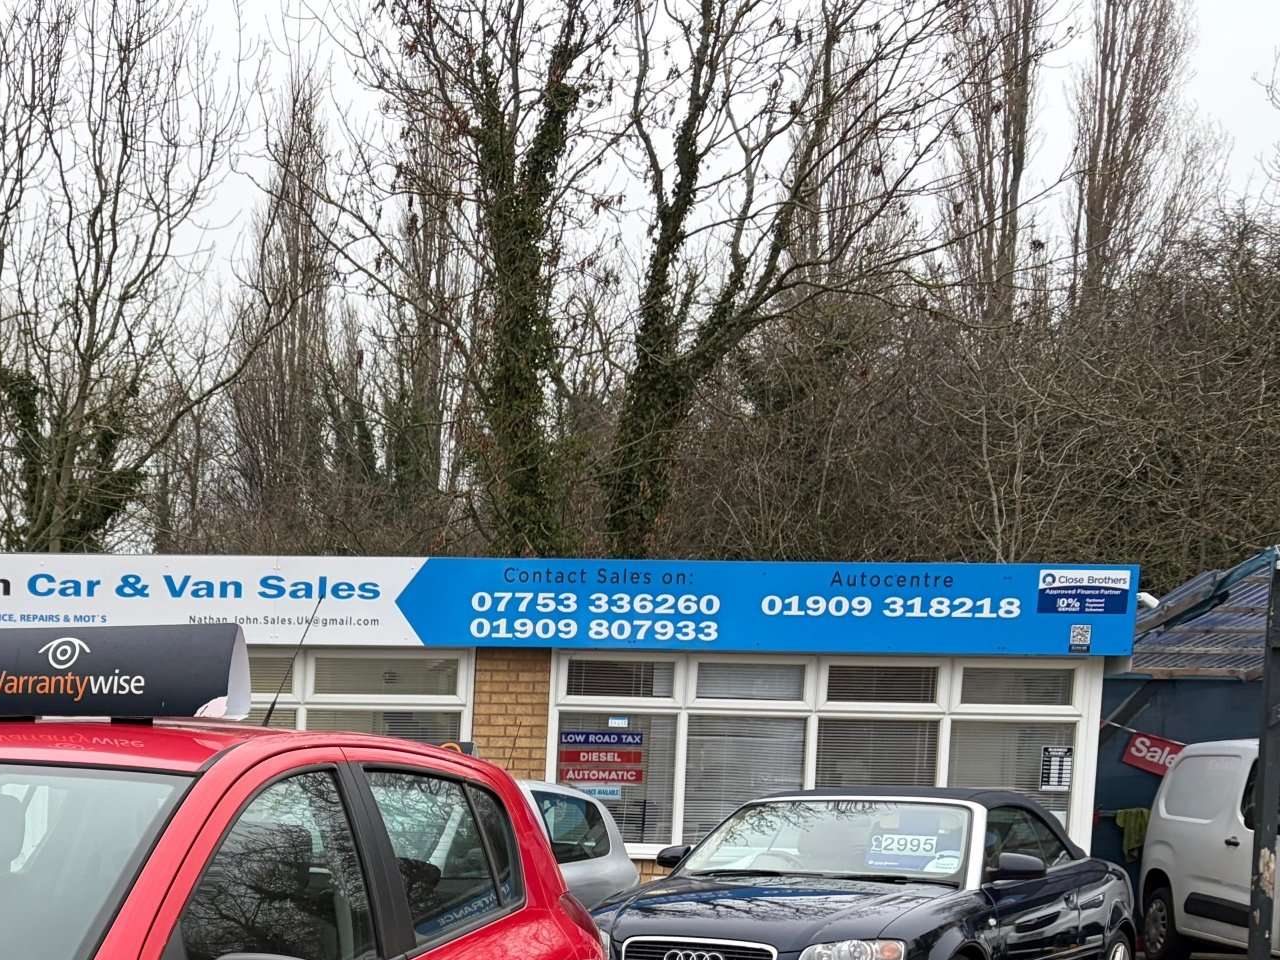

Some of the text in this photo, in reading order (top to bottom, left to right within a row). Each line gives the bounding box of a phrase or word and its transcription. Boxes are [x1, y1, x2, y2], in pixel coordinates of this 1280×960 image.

[504, 567, 694, 585] Contact Sales on:
[830, 570, 954, 588] Autocentre
[1058, 575, 1128, 586] Close Brothers
[27, 573, 101, 597] Car
[115, 574, 150, 598] &
[163, 575, 242, 599] Van
[257, 575, 381, 600] Sales
[1044, 588, 1076, 596] Approved
[471, 592, 720, 615] 07753 336260
[761, 595, 1021, 618] 01909 318218
[1059, 597, 1081, 608] 0%
[20, 614, 60, 622] REPAIRS
[63, 614, 71, 622] &
[189, 615, 380, 627] NathanJohn.Sales.Uk@gmail.com
[470, 618, 718, 641] 01909 807933
[562, 734, 641, 743] LOW ROAD TAX
[580, 752, 622, 762] DIESEL
[566, 769, 636, 780] AUTOMATIC
[871, 836, 935, 852] £2995
